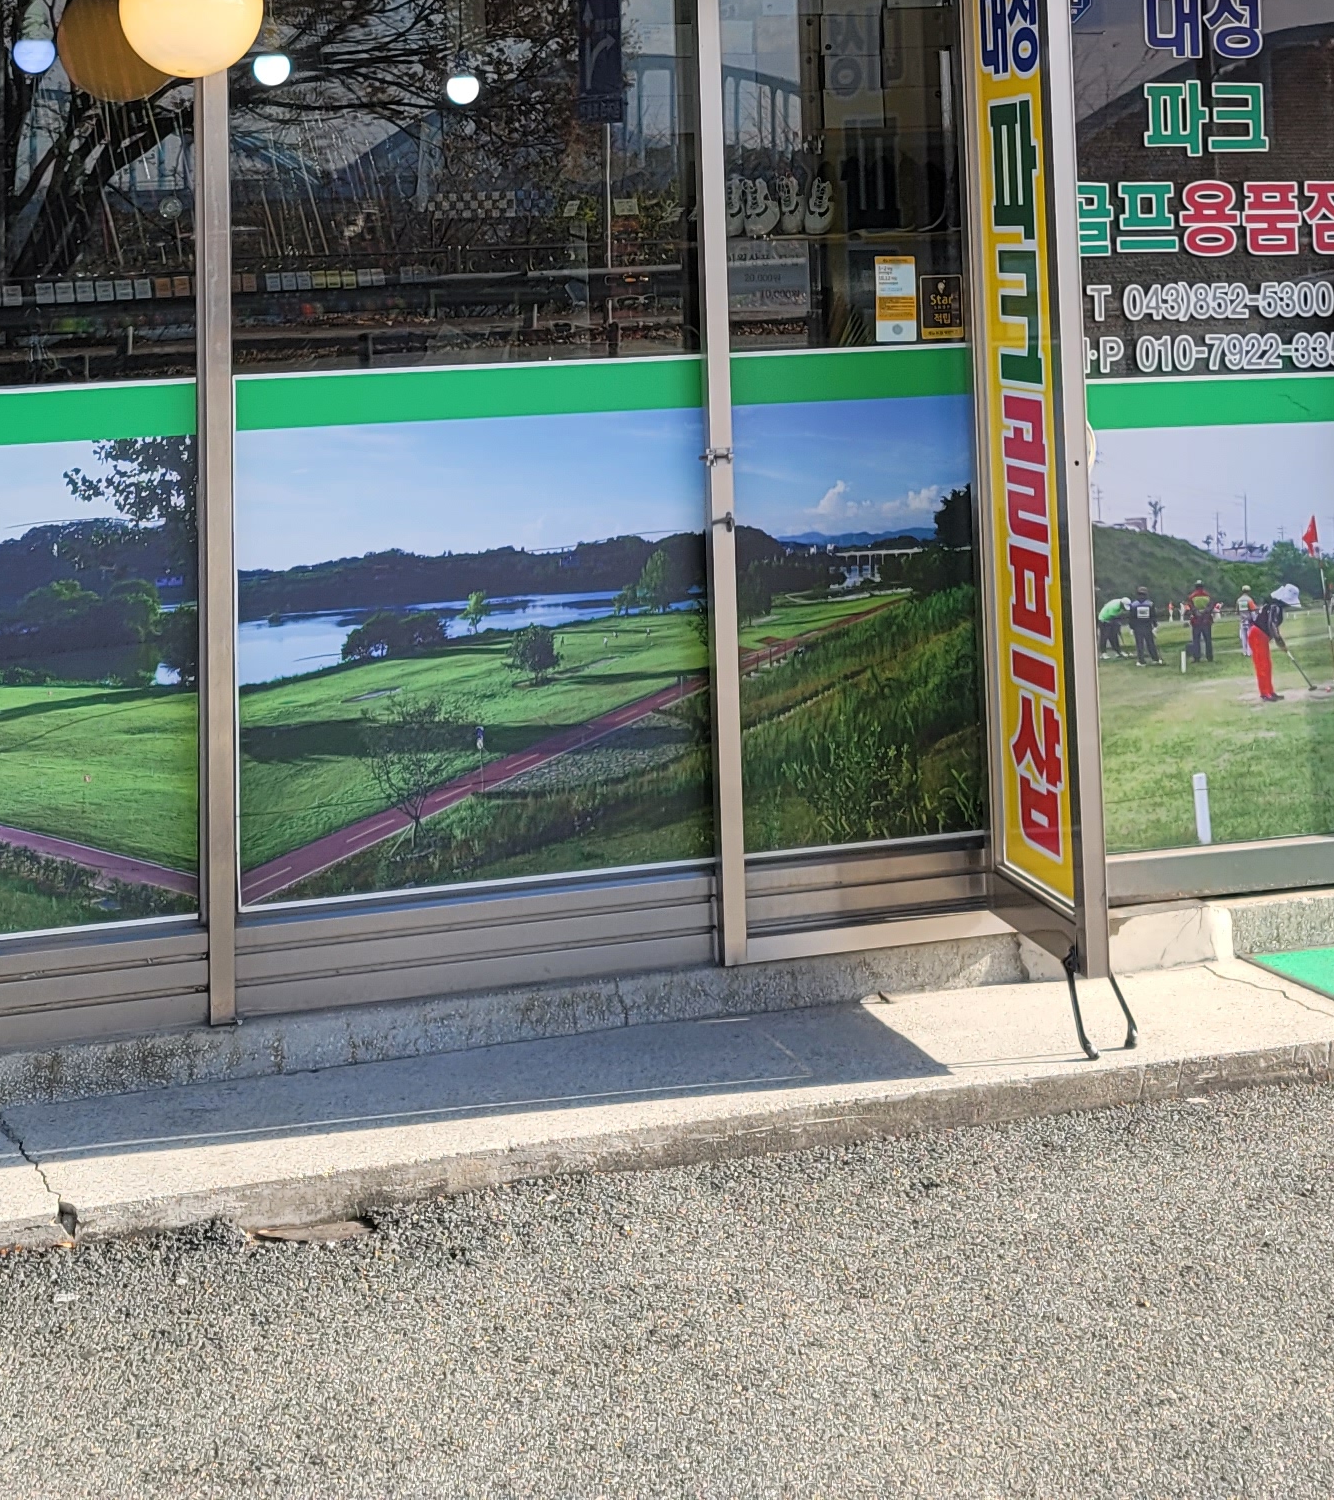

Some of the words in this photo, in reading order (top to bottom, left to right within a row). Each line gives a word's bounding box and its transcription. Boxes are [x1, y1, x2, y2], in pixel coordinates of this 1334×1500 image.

[1143, 79, 1269, 157] 파크
[1087, 285, 1112, 321] T
[1122, 280, 1334, 323] 043)852-5300
